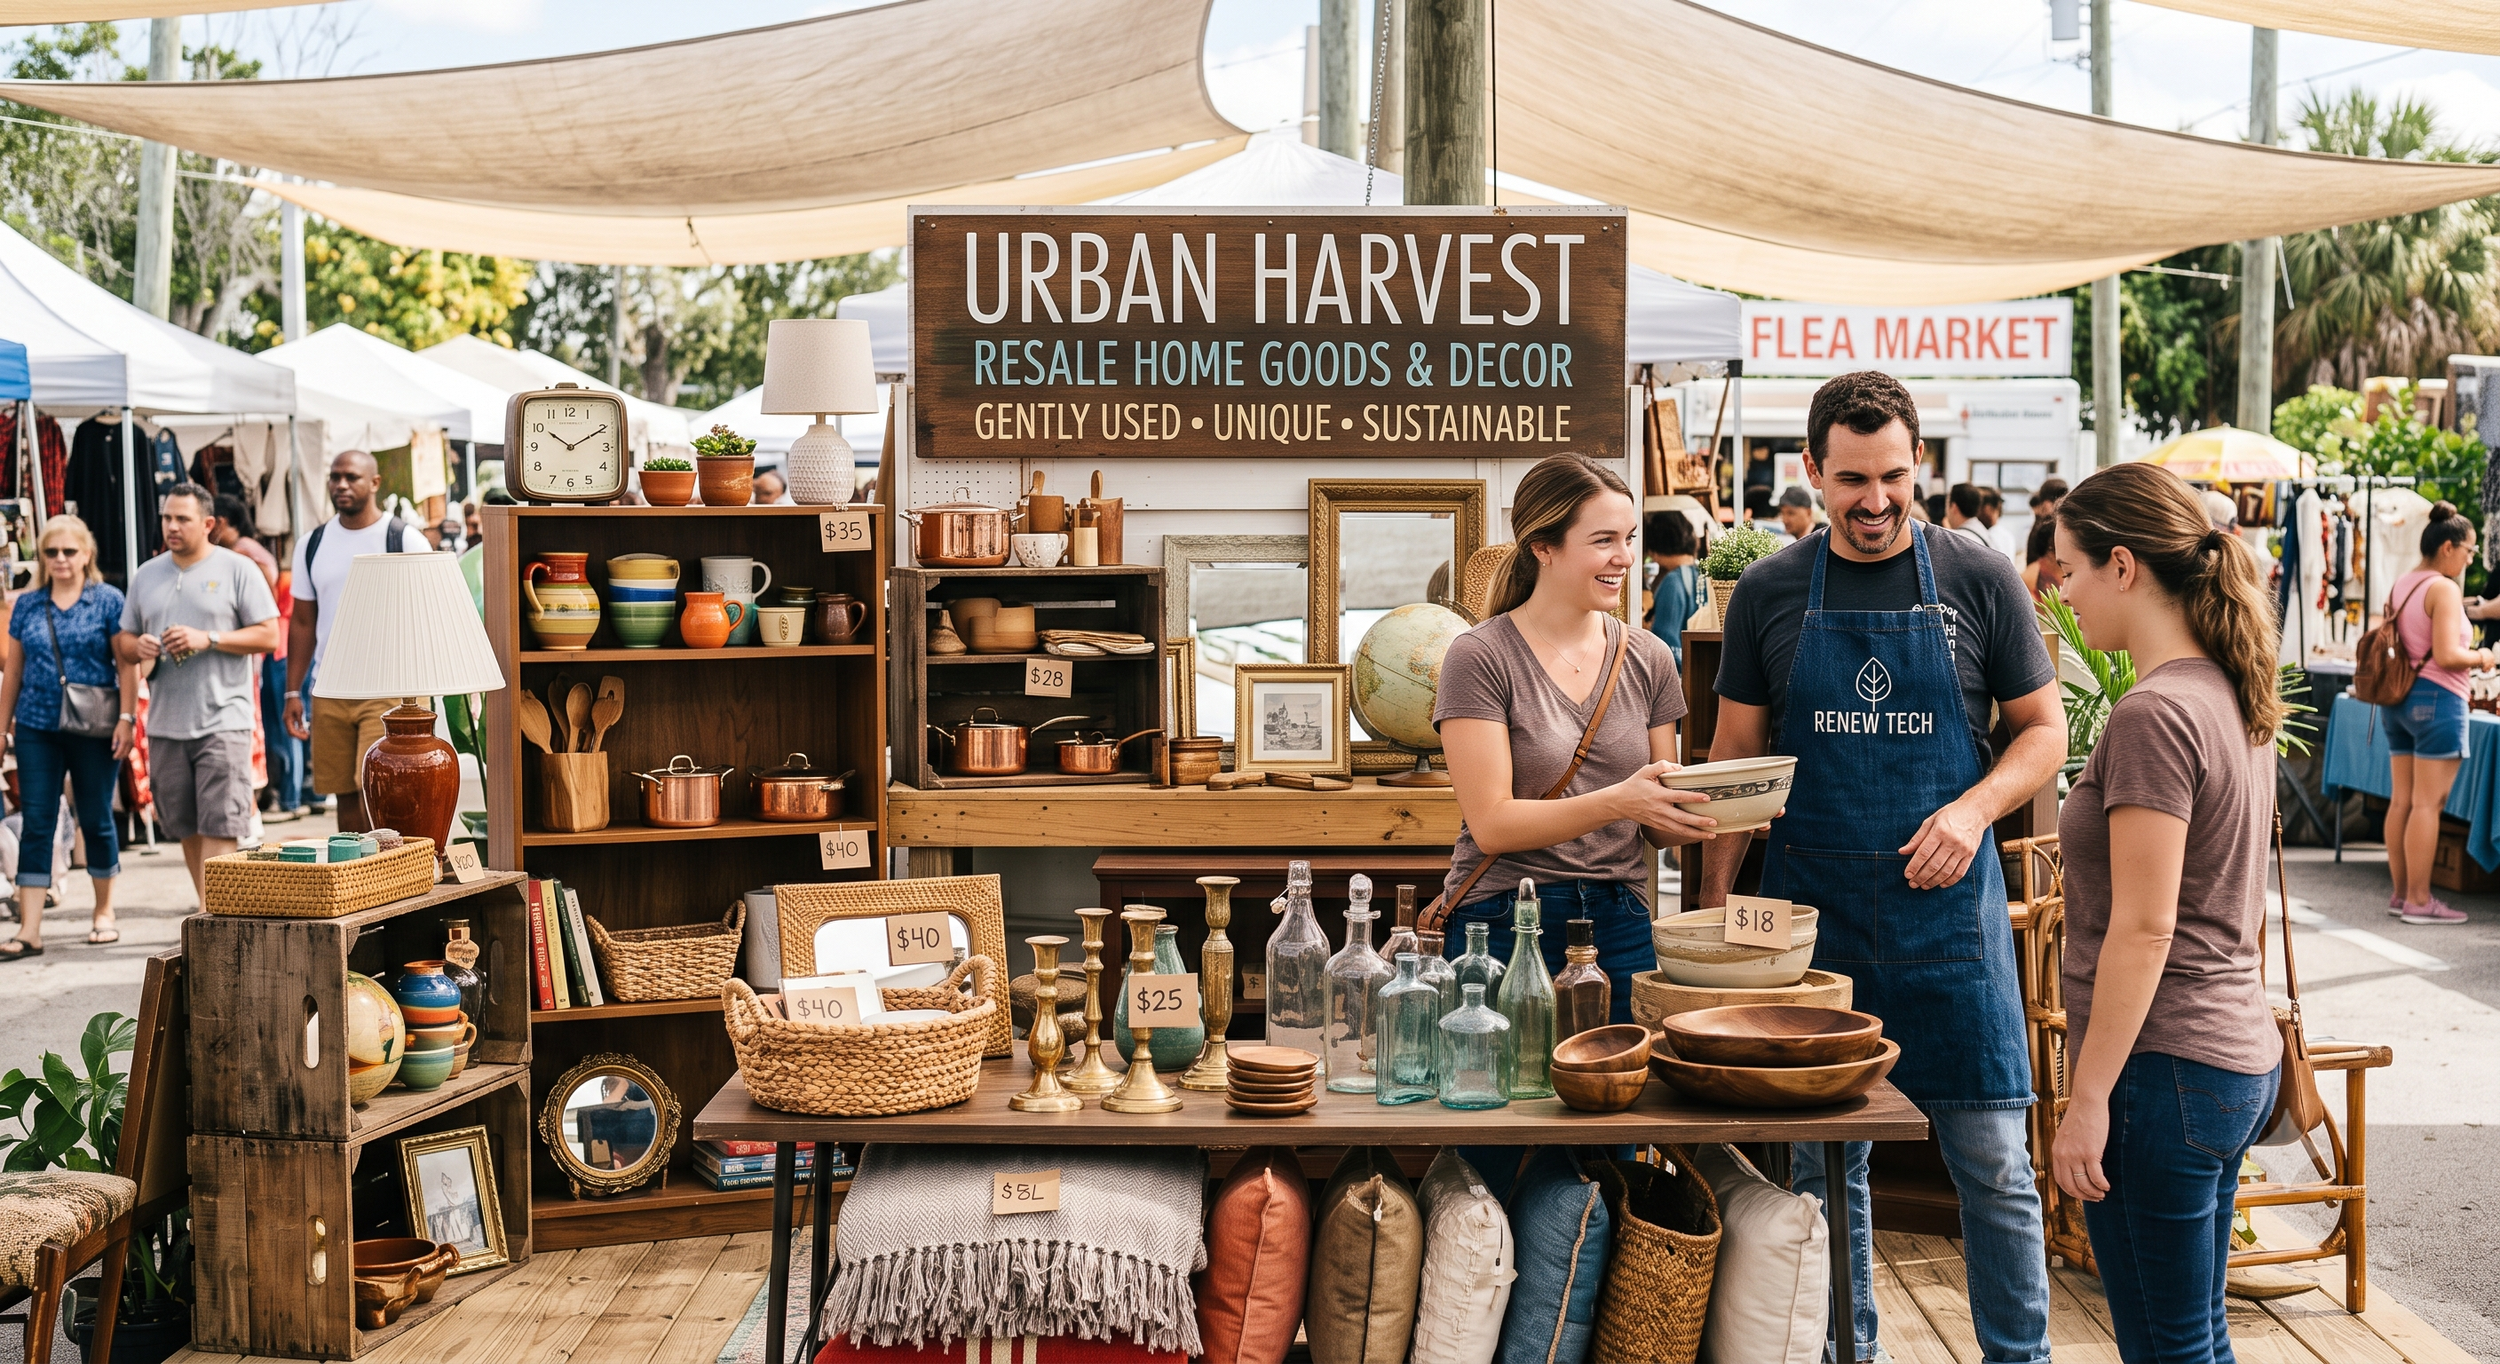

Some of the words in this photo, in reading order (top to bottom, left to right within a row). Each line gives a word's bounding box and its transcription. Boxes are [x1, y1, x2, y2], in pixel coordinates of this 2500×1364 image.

[966, 232, 1216, 324] URBAN
[1255, 233, 1585, 326] HARVEST
[1751, 317, 1856, 359] FLEA
[1874, 317, 2059, 360] MARKET
[975, 339, 1118, 386] RESALE
[1135, 340, 1245, 386] HOME
[1260, 341, 1391, 387] GOODS
[1405, 341, 1434, 387] &
[1450, 342, 1573, 388] DECOR
[547, 409, 556, 420] 11
[564, 407, 576, 418] 12
[532, 422, 545, 433] 10
[975, 402, 1091, 440] GENTLY
[1102, 403, 1181, 441] USED
[1214, 403, 1331, 445] UNIQUE
[1362, 403, 1571, 442] SUSTAINABLE
[530, 442, 539, 452] 9
[602, 442, 610, 453] 3
[533, 461, 542, 472] 8
[599, 461, 608, 472] 4
[549, 474, 557, 485] 7
[566, 478, 575, 488] 6
[585, 475, 593, 485] 5
[825, 520, 863, 542] $35
[1030, 666, 1064, 687] $28
[1814, 710, 1880, 734] RENEW
[1885, 712, 1933, 735] TECH
[825, 839, 859, 860] $40
[1734, 905, 1774, 933] $18
[896, 926, 941, 952] $40
[797, 997, 843, 1019] $40
[1137, 986, 1183, 1014] $25
